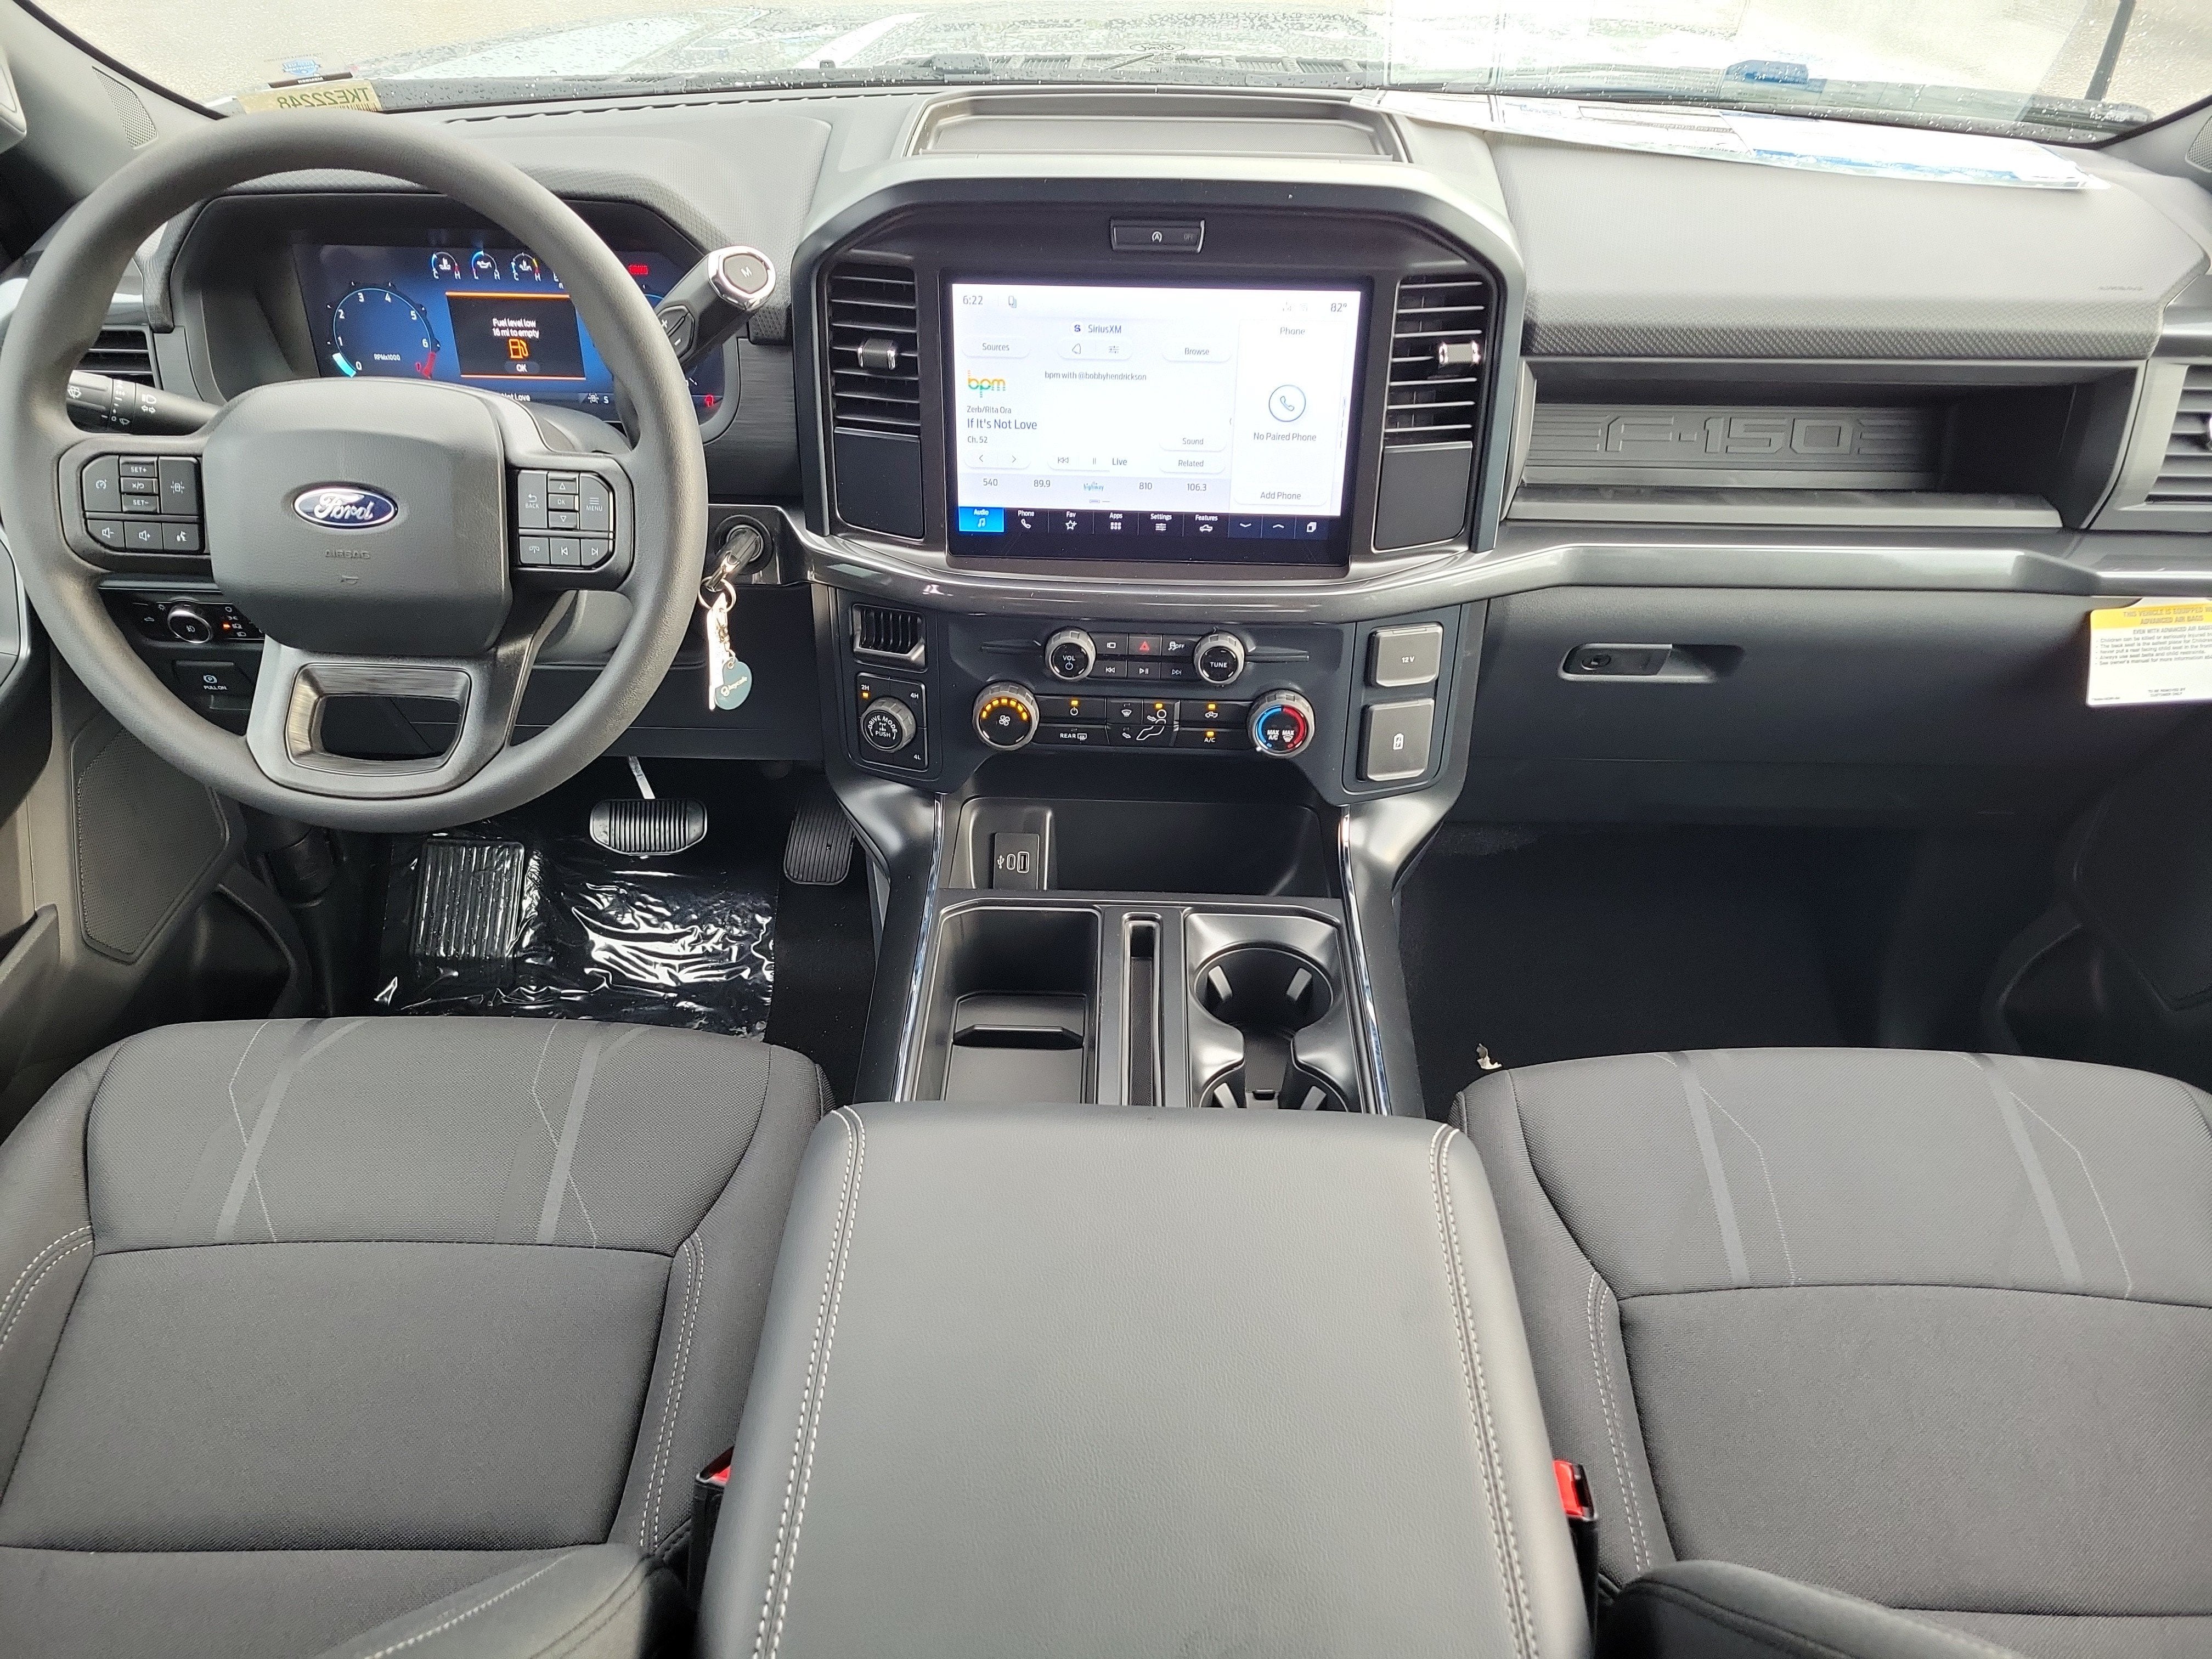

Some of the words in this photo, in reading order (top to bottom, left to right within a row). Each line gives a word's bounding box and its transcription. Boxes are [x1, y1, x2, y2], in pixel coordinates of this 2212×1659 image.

[455, 270, 461, 280] H
[535, 272, 541, 281] H
[740, 266, 752, 278] M
[514, 273, 519, 281] C
[357, 292, 365, 302] 3
[385, 293, 391, 303] 4
[963, 295, 984, 306] 6:22
[338, 309, 346, 319] 2
[410, 311, 417, 320] 5
[492, 318, 507, 328] Fuel
[507, 318, 523, 328] level
[523, 319, 537, 328] low
[510, 329, 518, 337] to
[518, 329, 540, 338] empty
[1088, 324, 1122, 334] SiriusXM
[1279, 326, 1305, 335] Phone
[338, 336, 343, 346] 1
[422, 338, 429, 348] 6
[982, 342, 1010, 352] Sources
[1184, 347, 1210, 356] Browse
[356, 362, 362, 371] 0
[516, 364, 527, 373] OK
[1045, 371, 1060, 380] bpm
[1062, 371, 1077, 379] with
[1078, 371, 1147, 381] @bobbyhendrickson
[967, 369, 1006, 398] bpm
[514, 393, 531, 402] Love
[967, 405, 999, 414] Zerb/Rita
[967, 418, 975, 429] If
[977, 418, 991, 429] It's
[994, 419, 1012, 429] Not
[1014, 419, 1037, 430] Love
[1254, 432, 1264, 441] No
[1266, 432, 1290, 441] Paired
[1292, 433, 1317, 441] Phone
[1604, 415, 1854, 455] F-150
[1112, 458, 1127, 466] Live
[983, 478, 998, 487] 540
[1034, 479, 1051, 488] 89.9
[1187, 483, 1207, 492] 106.3
[1260, 491, 1276, 500] Add
[1277, 492, 1301, 500] Phone
[314, 493, 374, 520] Ford
[1109, 512, 1123, 520] Apps
[1150, 513, 1172, 522] Settings
[868, 715, 881, 730] DRIVE
[882, 716, 898, 733] MODE
